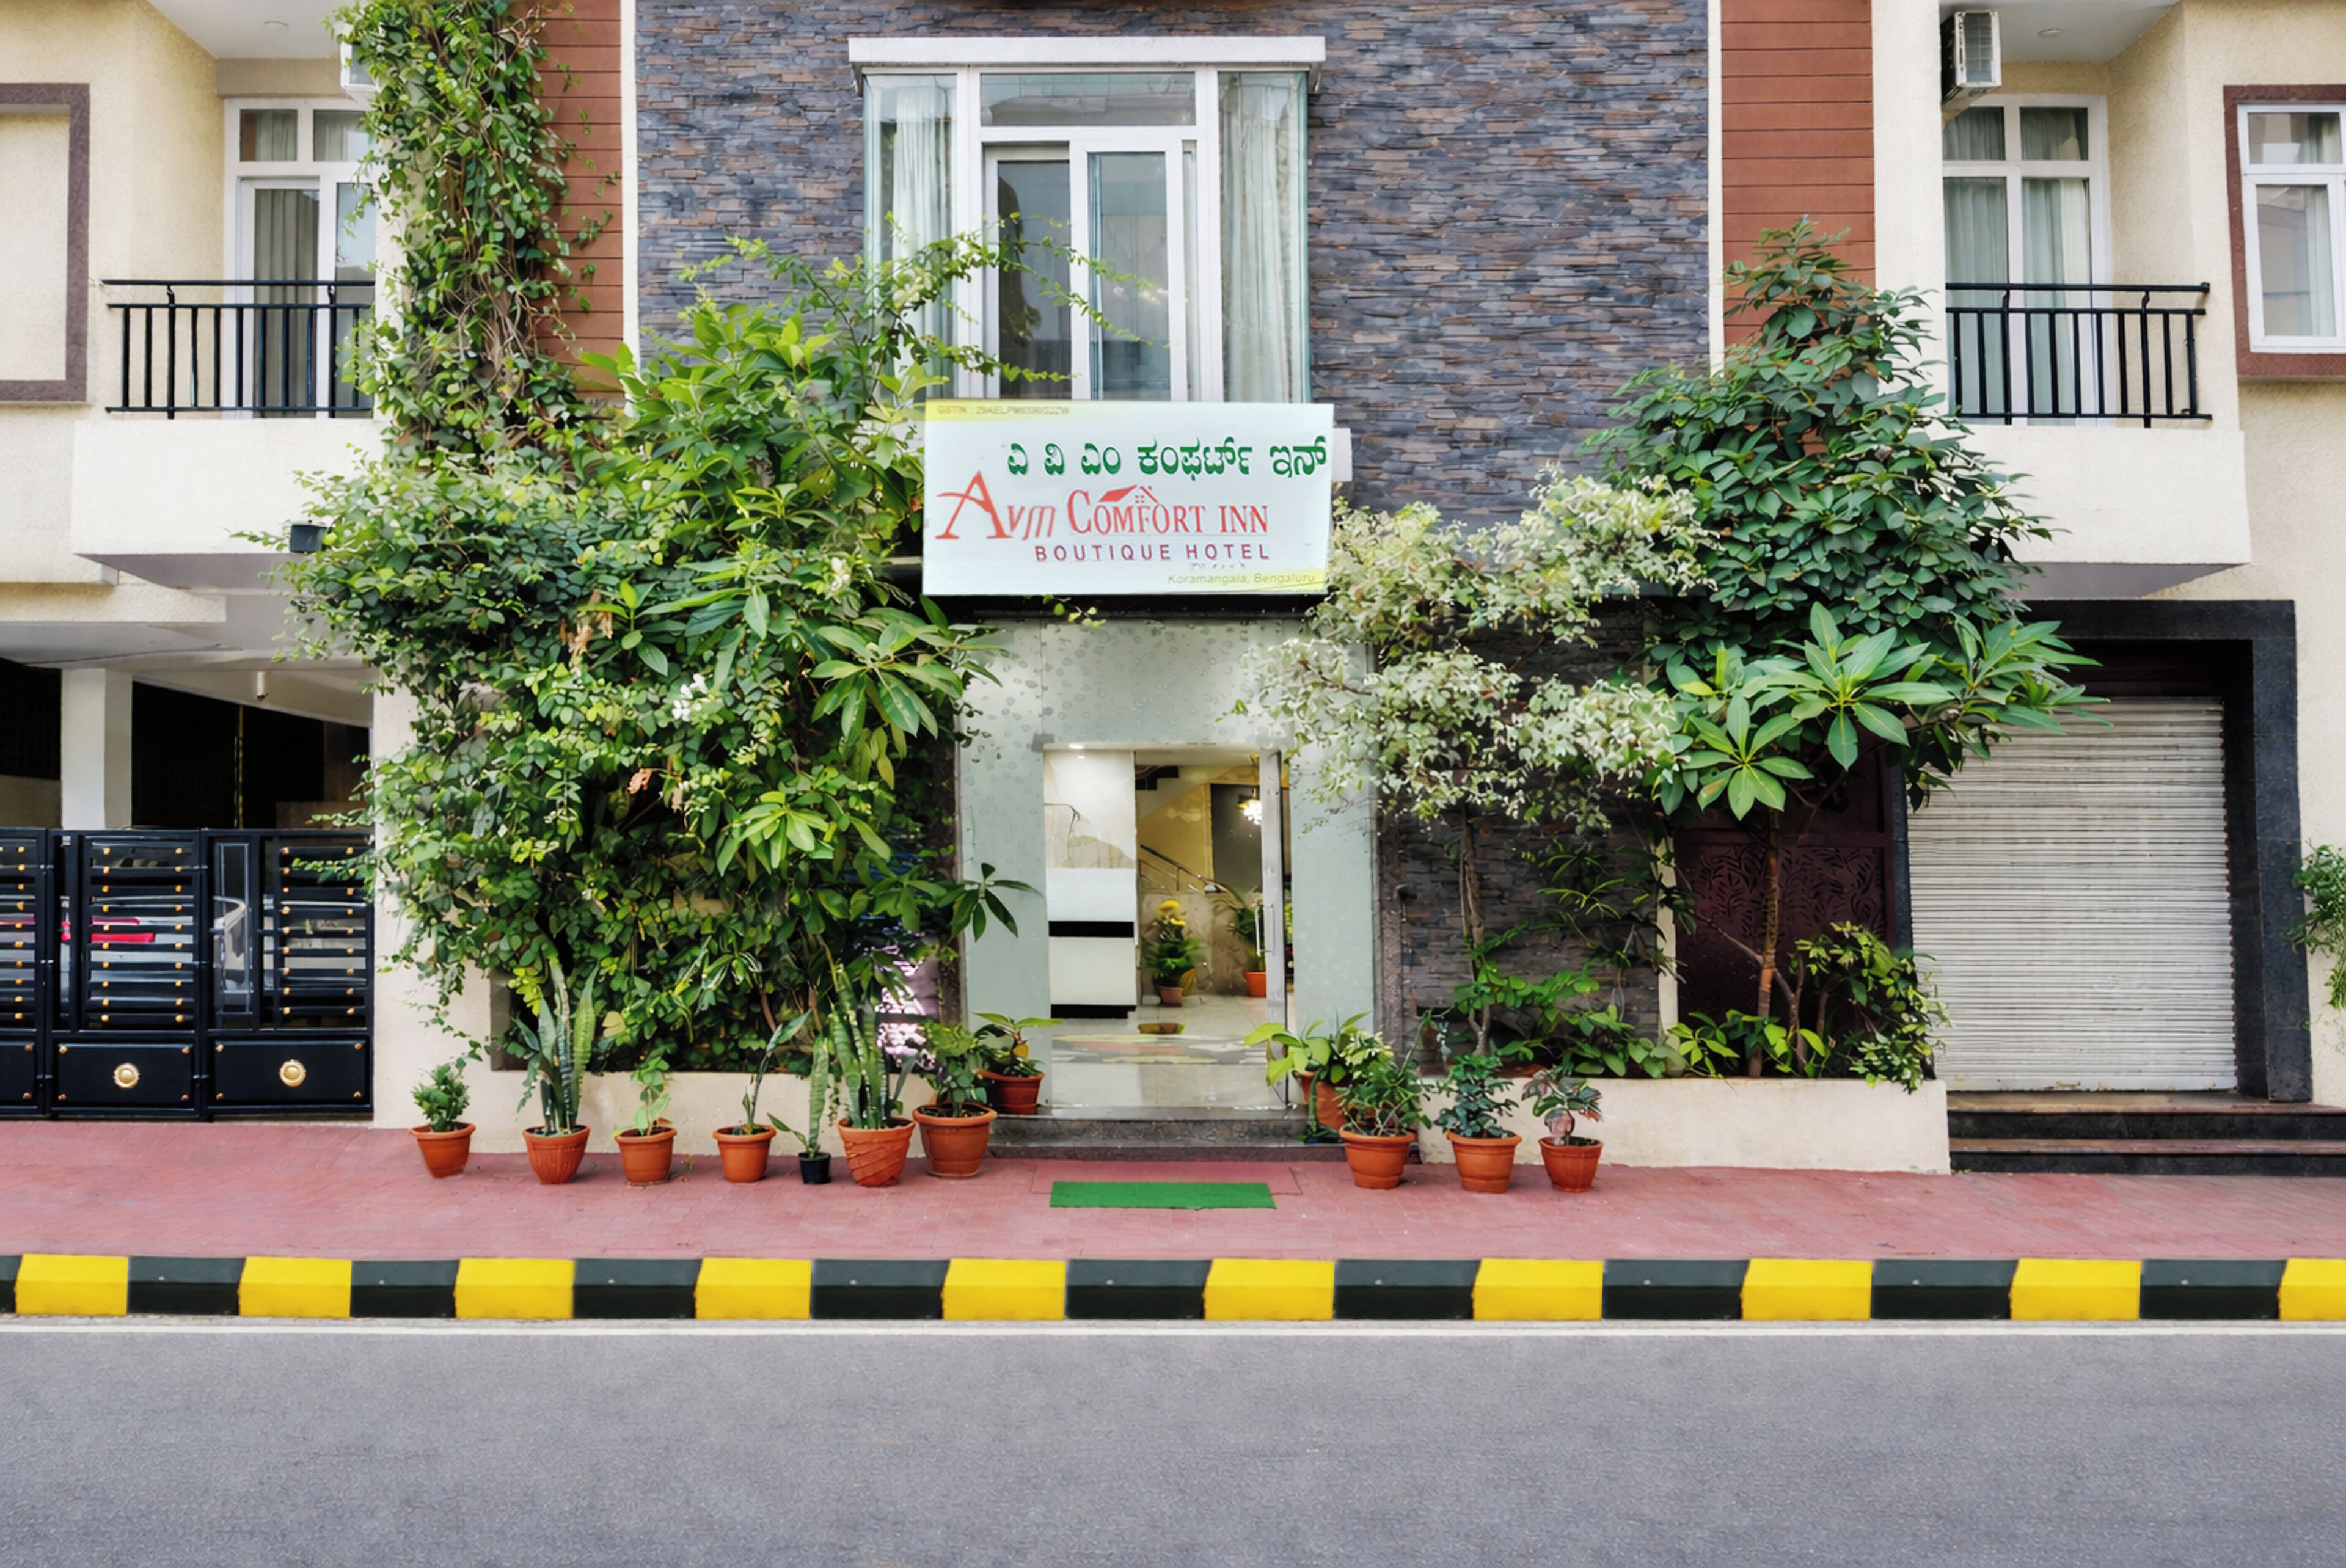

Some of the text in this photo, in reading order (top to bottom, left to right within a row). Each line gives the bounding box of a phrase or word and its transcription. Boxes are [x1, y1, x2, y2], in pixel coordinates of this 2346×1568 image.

[1043, 442, 1065, 475] ವಿ
[1268, 435, 1328, 479] ಇನ್
[1219, 505, 1268, 533] INN
[1034, 544, 1269, 562] BOUTIQUE HOTEL
[1167, 572, 1315, 586] Koramangala, Bengaluru
